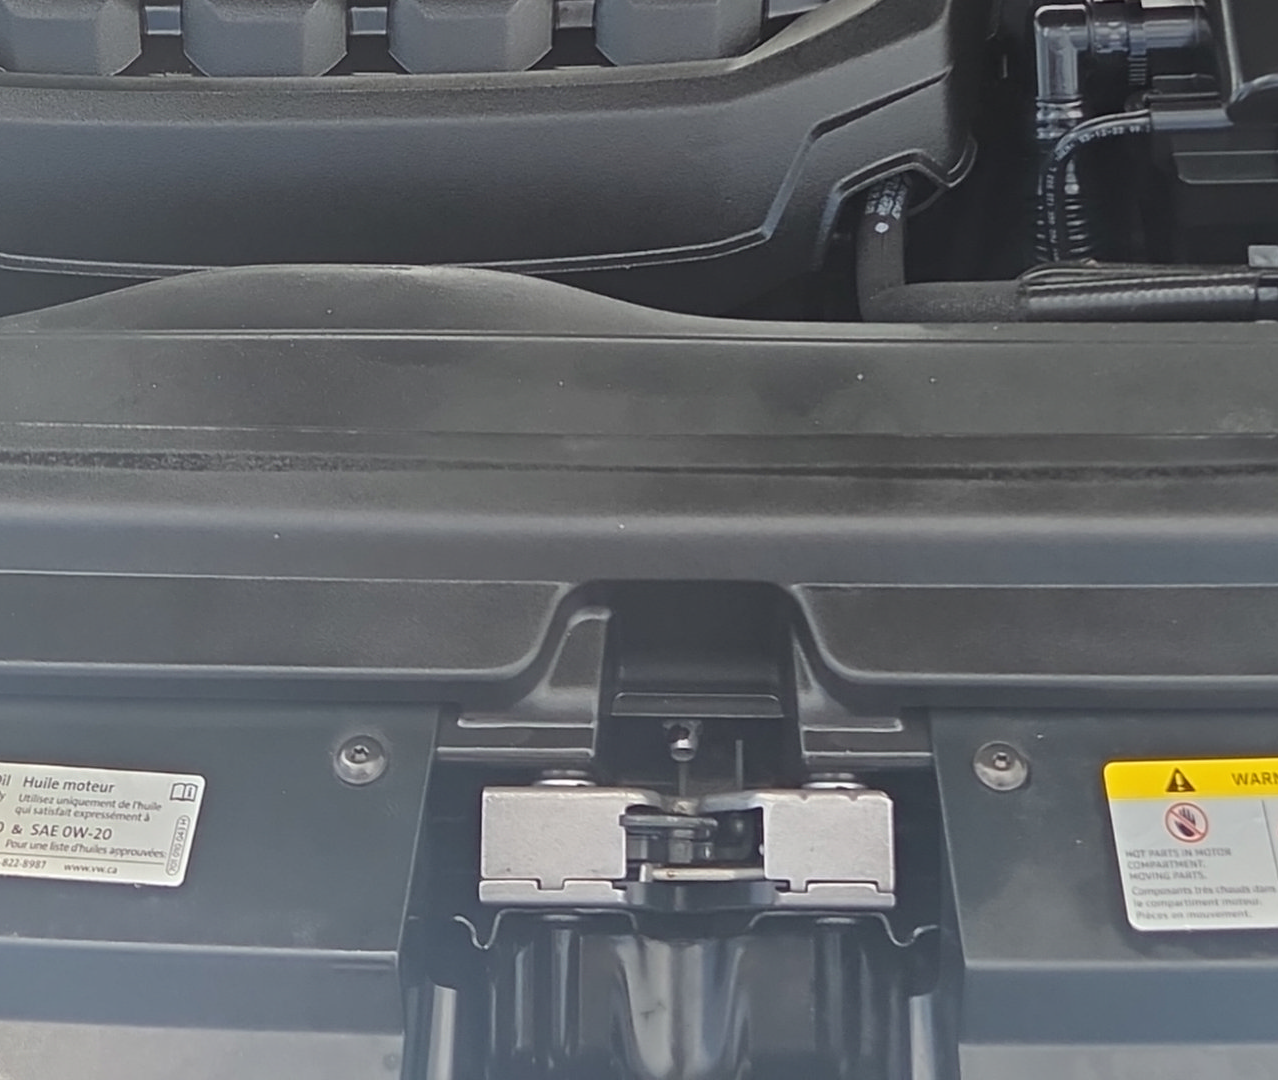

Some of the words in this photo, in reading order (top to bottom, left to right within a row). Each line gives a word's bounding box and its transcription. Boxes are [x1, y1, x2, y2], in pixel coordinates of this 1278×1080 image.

[23, 776, 60, 790] Huile
[63, 781, 115, 793] moteur
[19, 795, 54, 805] Utilisez
[56, 798, 116, 809] uniquement
[119, 801, 131, 809] de
[15, 807, 31, 815] qui
[33, 807, 71, 817] satisfait
[12, 824, 22, 834] &
[30, 824, 59, 837] SAE
[62, 825, 112, 840] 0W-20
[5, 839, 28, 848] Pour
[30, 842, 48, 850] une
[50, 842, 69, 852] liste
[1149, 849, 1179, 857] PARTS
[1196, 848, 1232, 856] MOTOR
